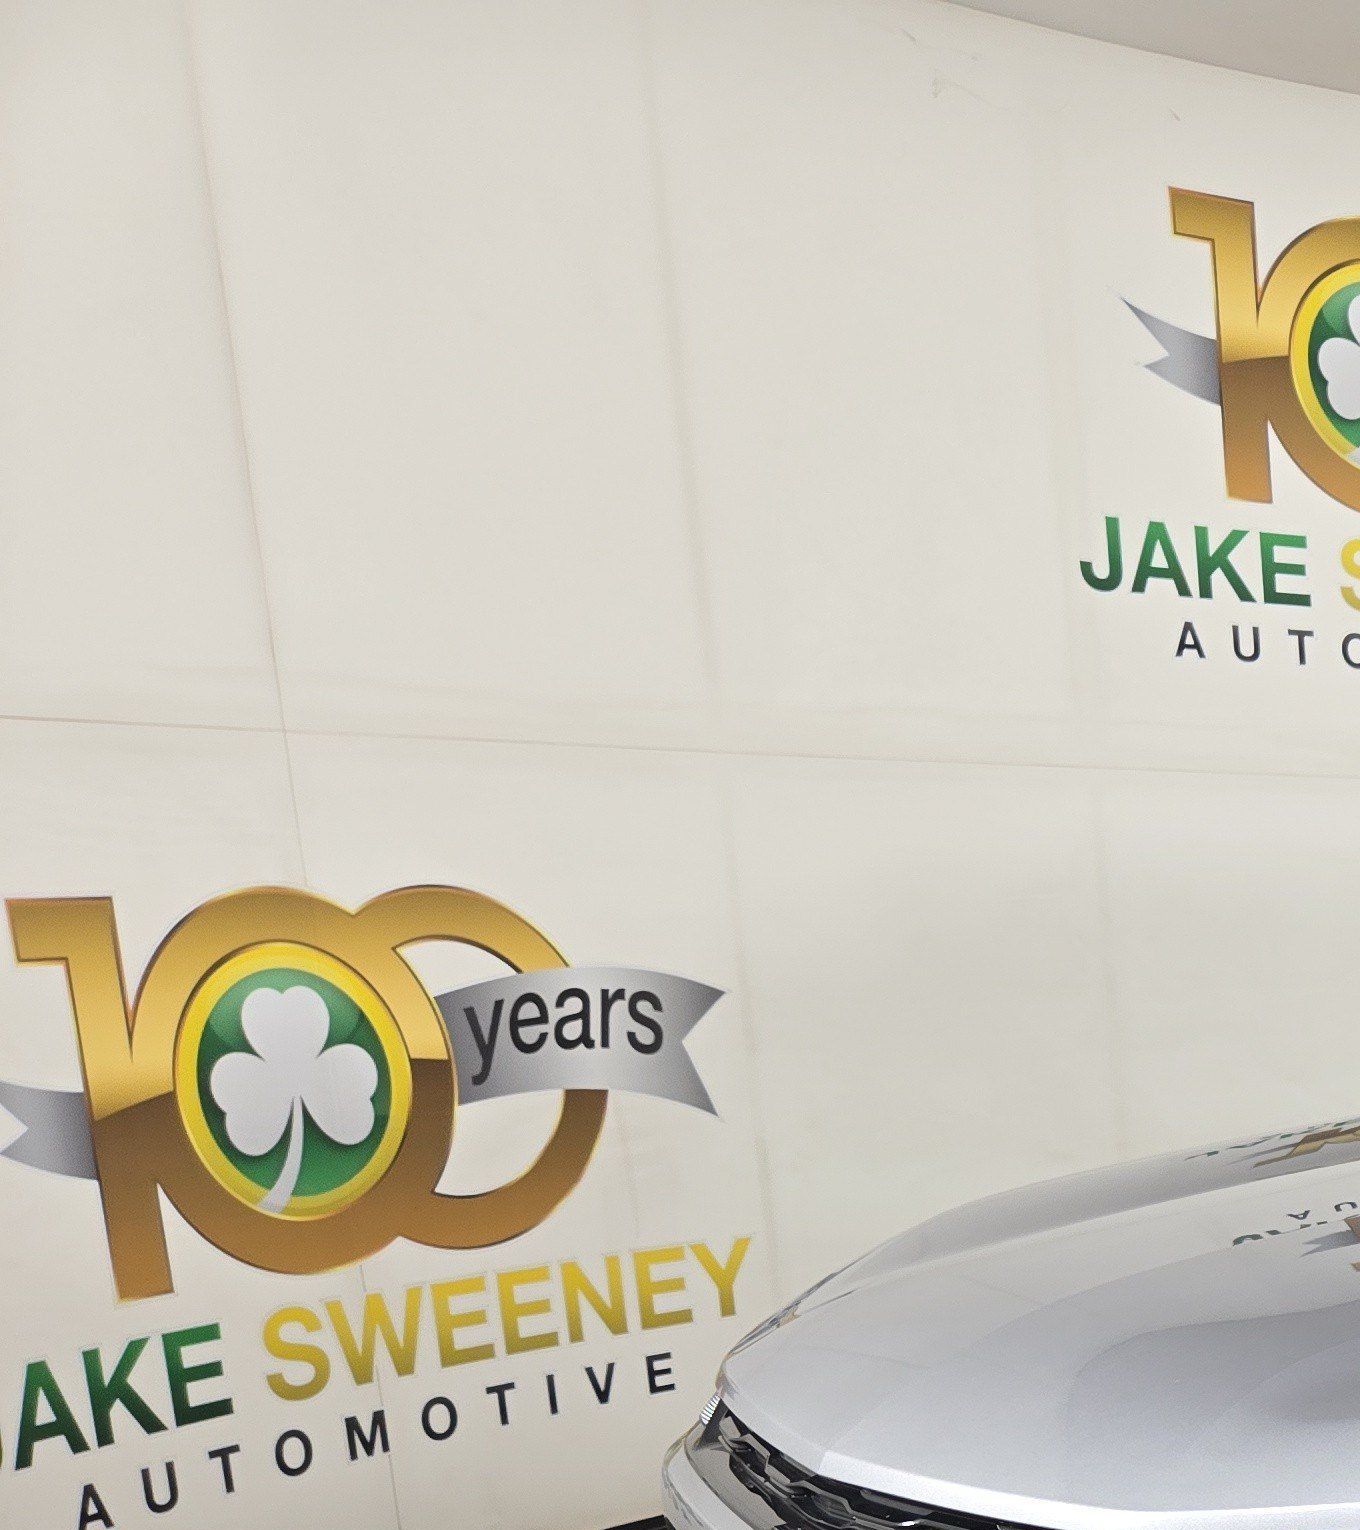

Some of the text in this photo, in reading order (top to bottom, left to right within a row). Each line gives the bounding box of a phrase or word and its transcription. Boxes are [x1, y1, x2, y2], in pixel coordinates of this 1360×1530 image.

[1079, 516, 1313, 608] JAKE
[7, 884, 609, 1301] 100
[463, 987, 665, 1087] years
[0, 1237, 752, 1475] AKE SWEENEY
